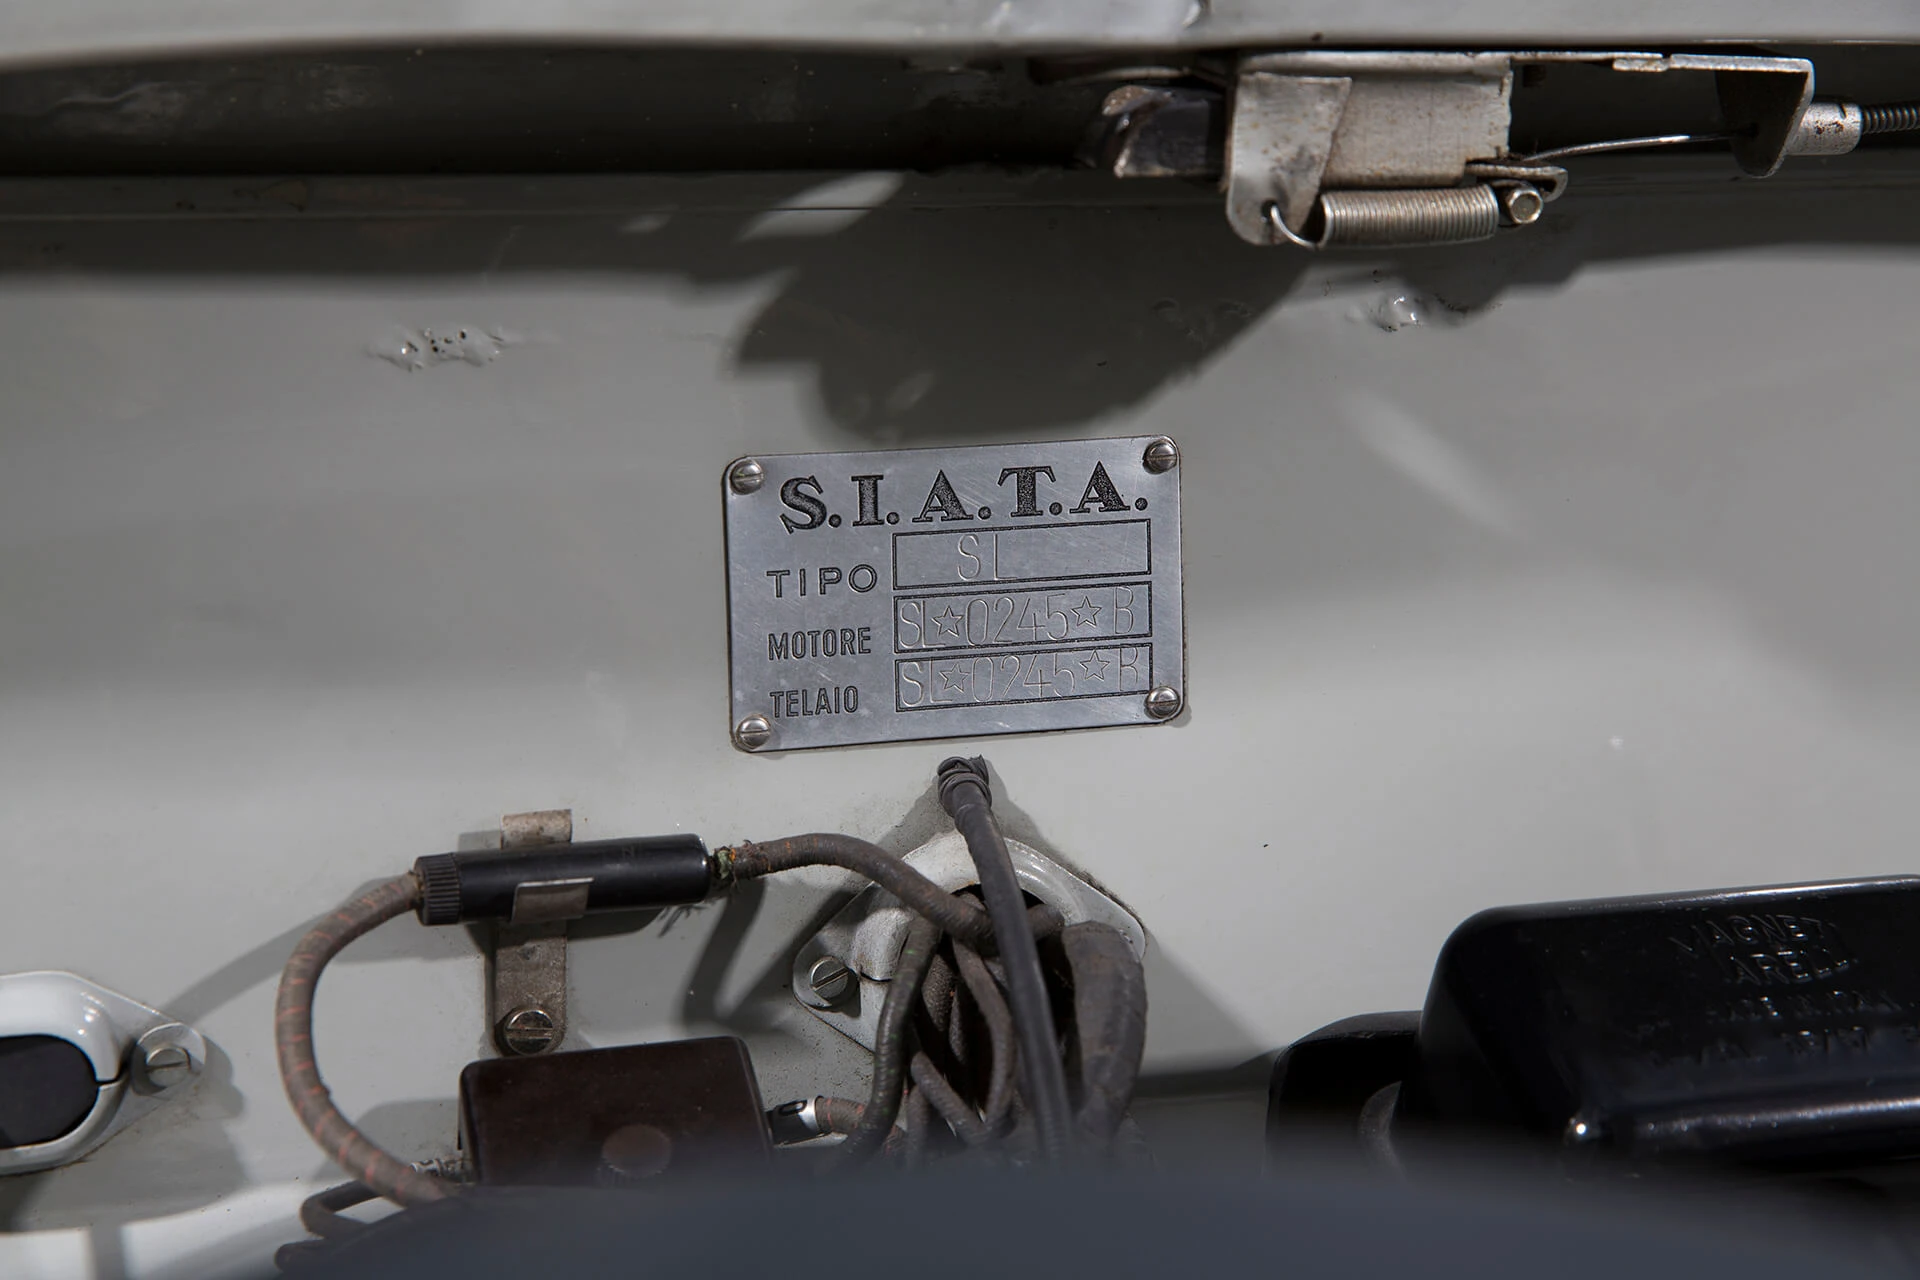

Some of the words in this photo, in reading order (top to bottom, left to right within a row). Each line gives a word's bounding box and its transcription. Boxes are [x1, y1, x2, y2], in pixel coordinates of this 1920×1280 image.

[779, 460, 1149, 535] S.I.A.T.A.
[766, 563, 878, 599] TIPO
[956, 532, 1018, 582] SL
[767, 626, 871, 661] MOTORE
[769, 685, 859, 719] TELAIO
